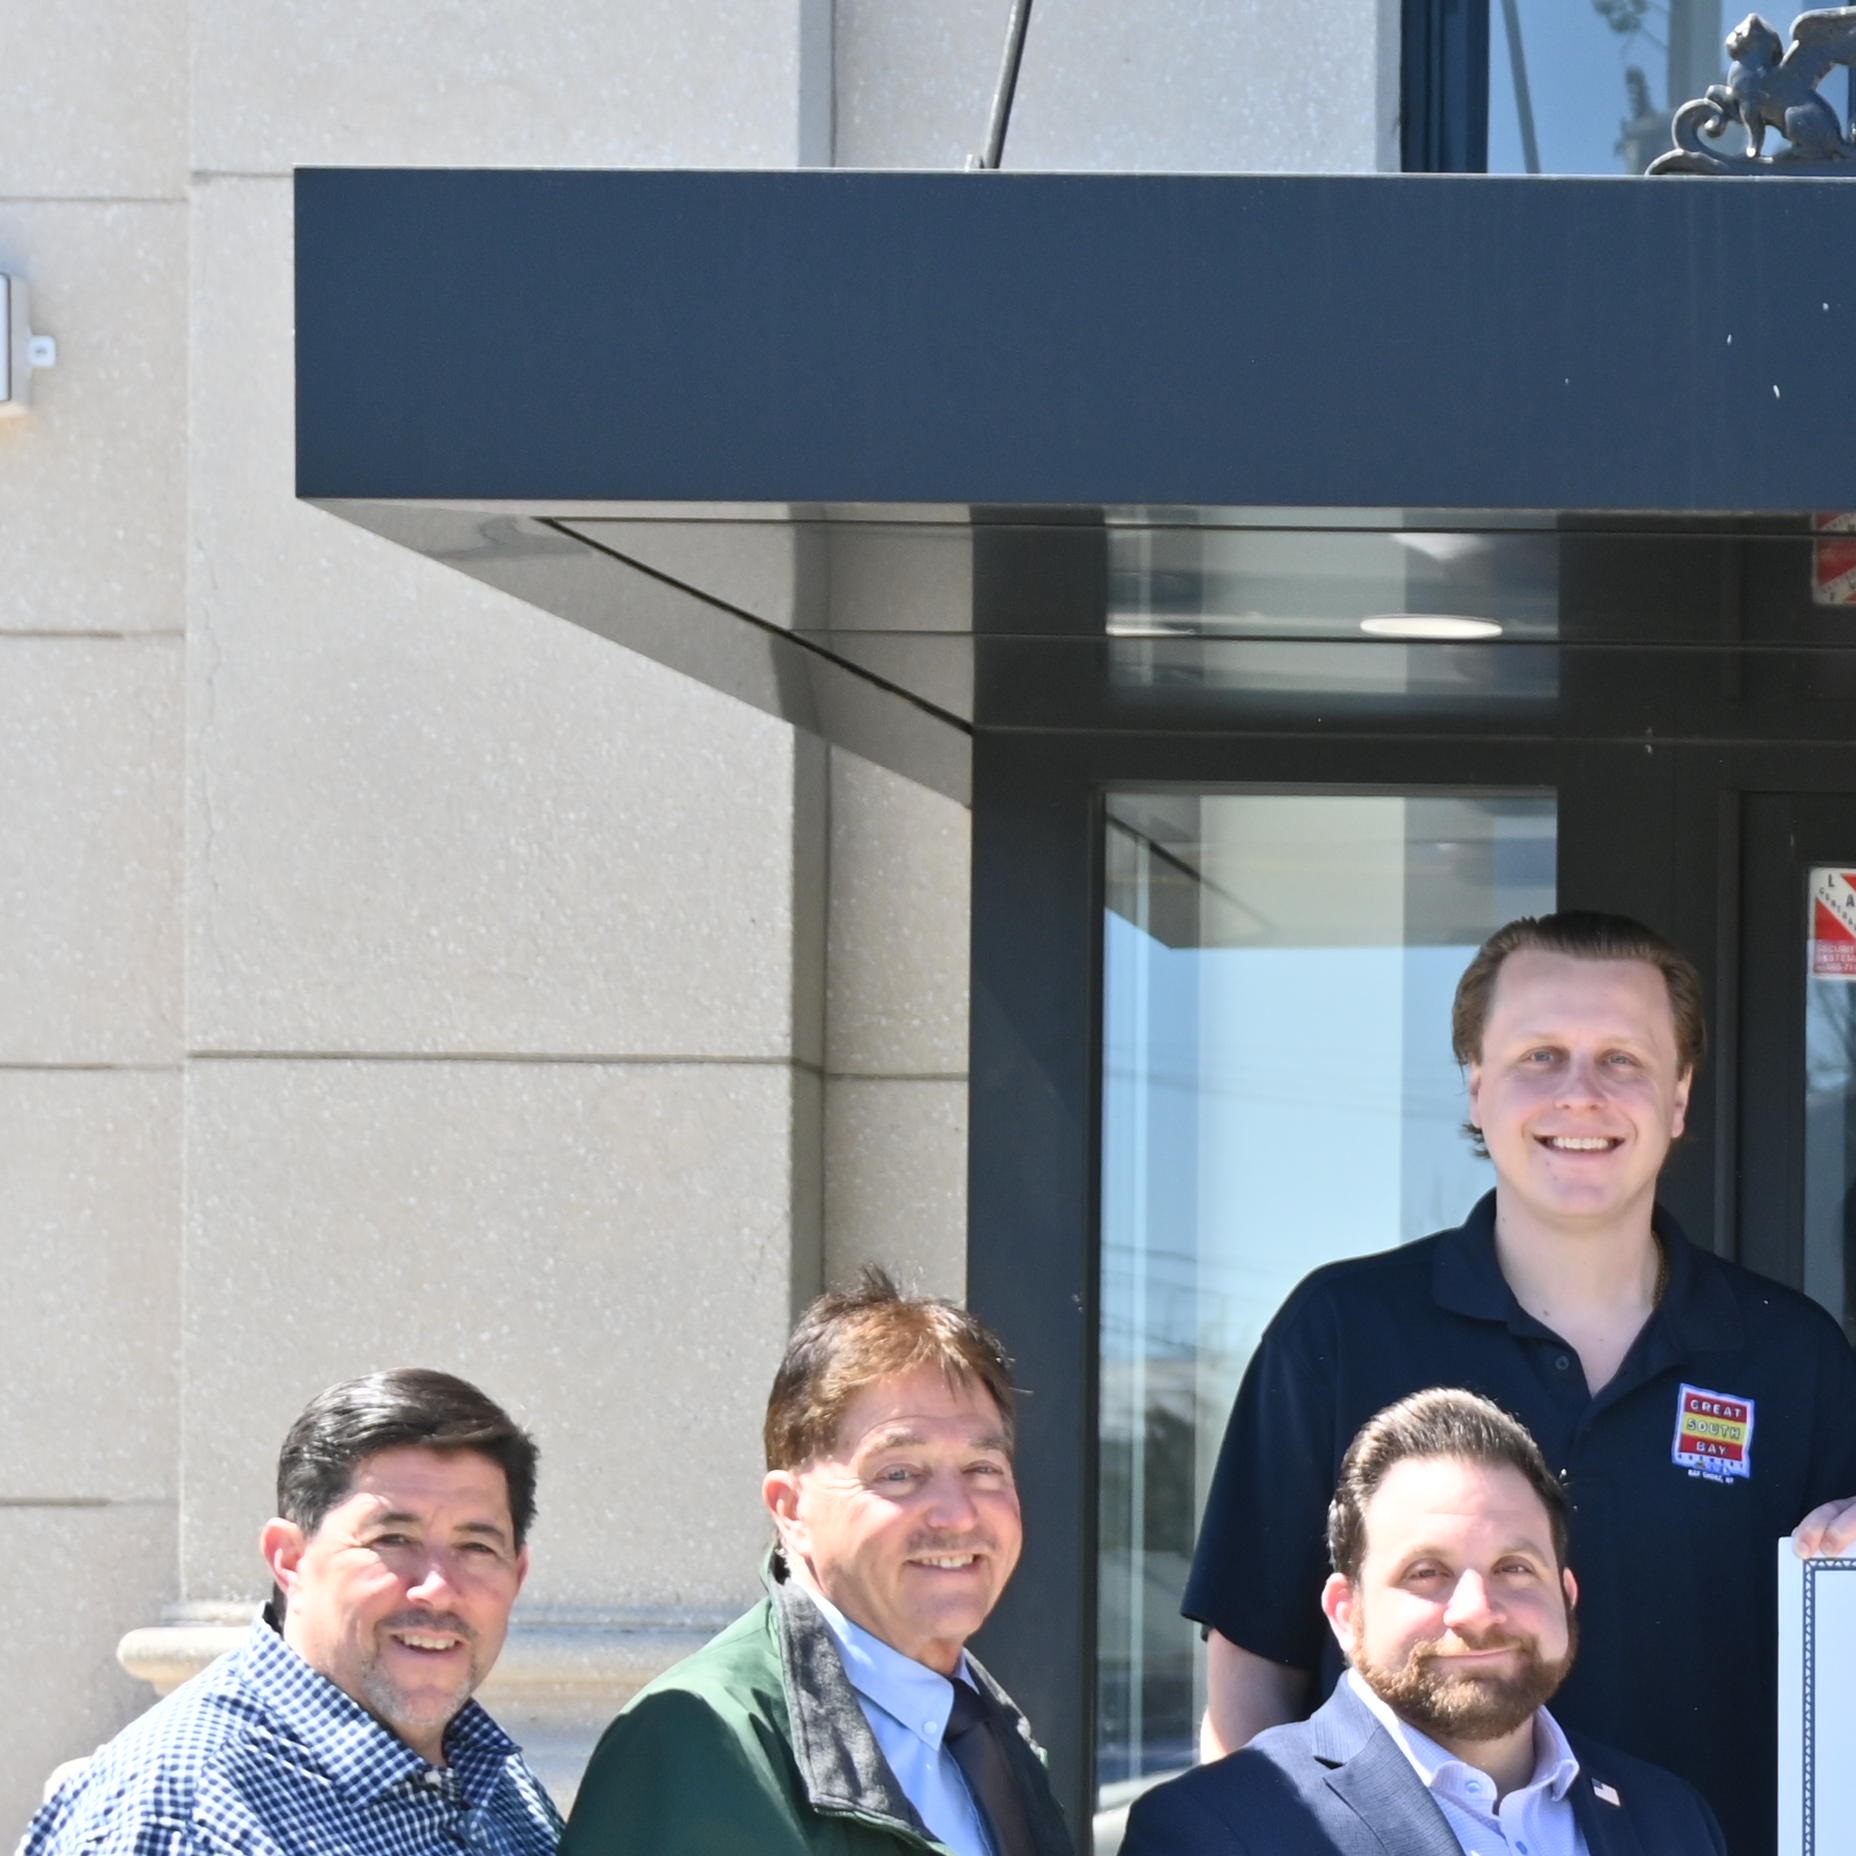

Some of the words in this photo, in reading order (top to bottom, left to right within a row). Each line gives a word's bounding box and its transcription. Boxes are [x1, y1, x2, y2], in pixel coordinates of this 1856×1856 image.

[1690, 1399, 1741, 1418] GREAT
[1687, 1419, 1741, 1440] SOUTH
[1696, 1441, 1727, 1456] BAY
